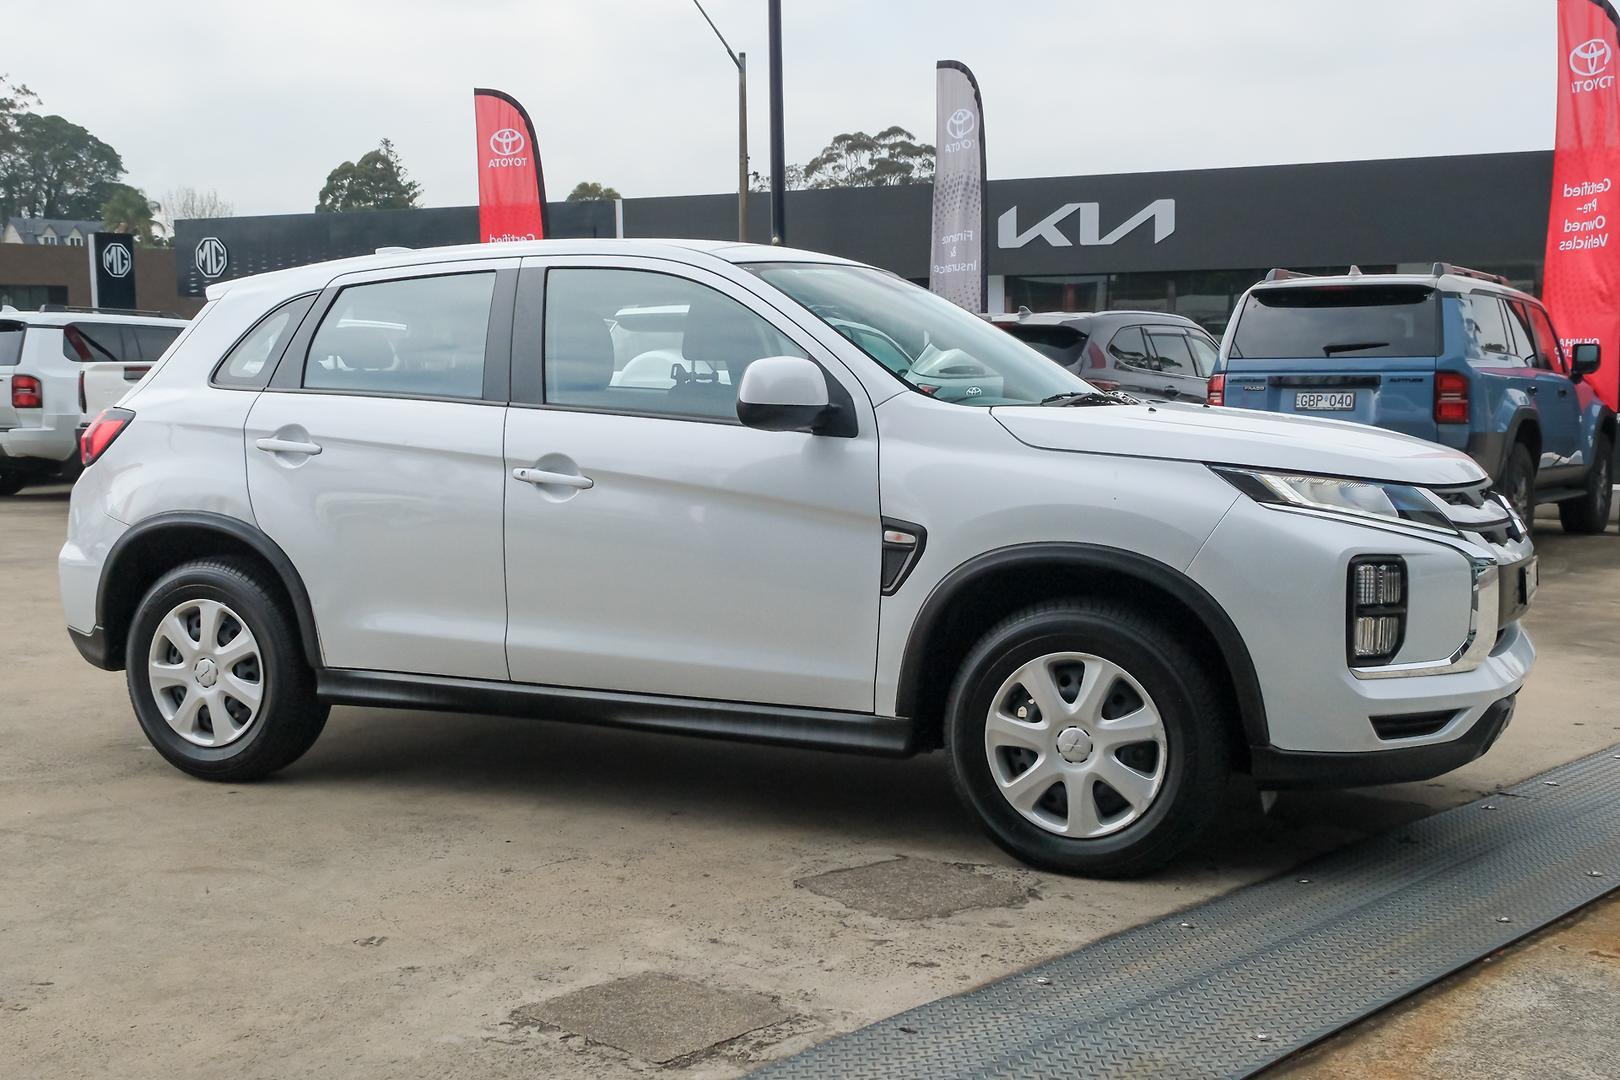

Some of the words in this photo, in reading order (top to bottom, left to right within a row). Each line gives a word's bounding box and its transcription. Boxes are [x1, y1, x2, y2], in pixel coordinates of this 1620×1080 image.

[998, 199, 1175, 249] KIA
[104, 245, 130, 276] MG
[198, 240, 225, 276] MG
[1300, 394, 1324, 407] GBP
